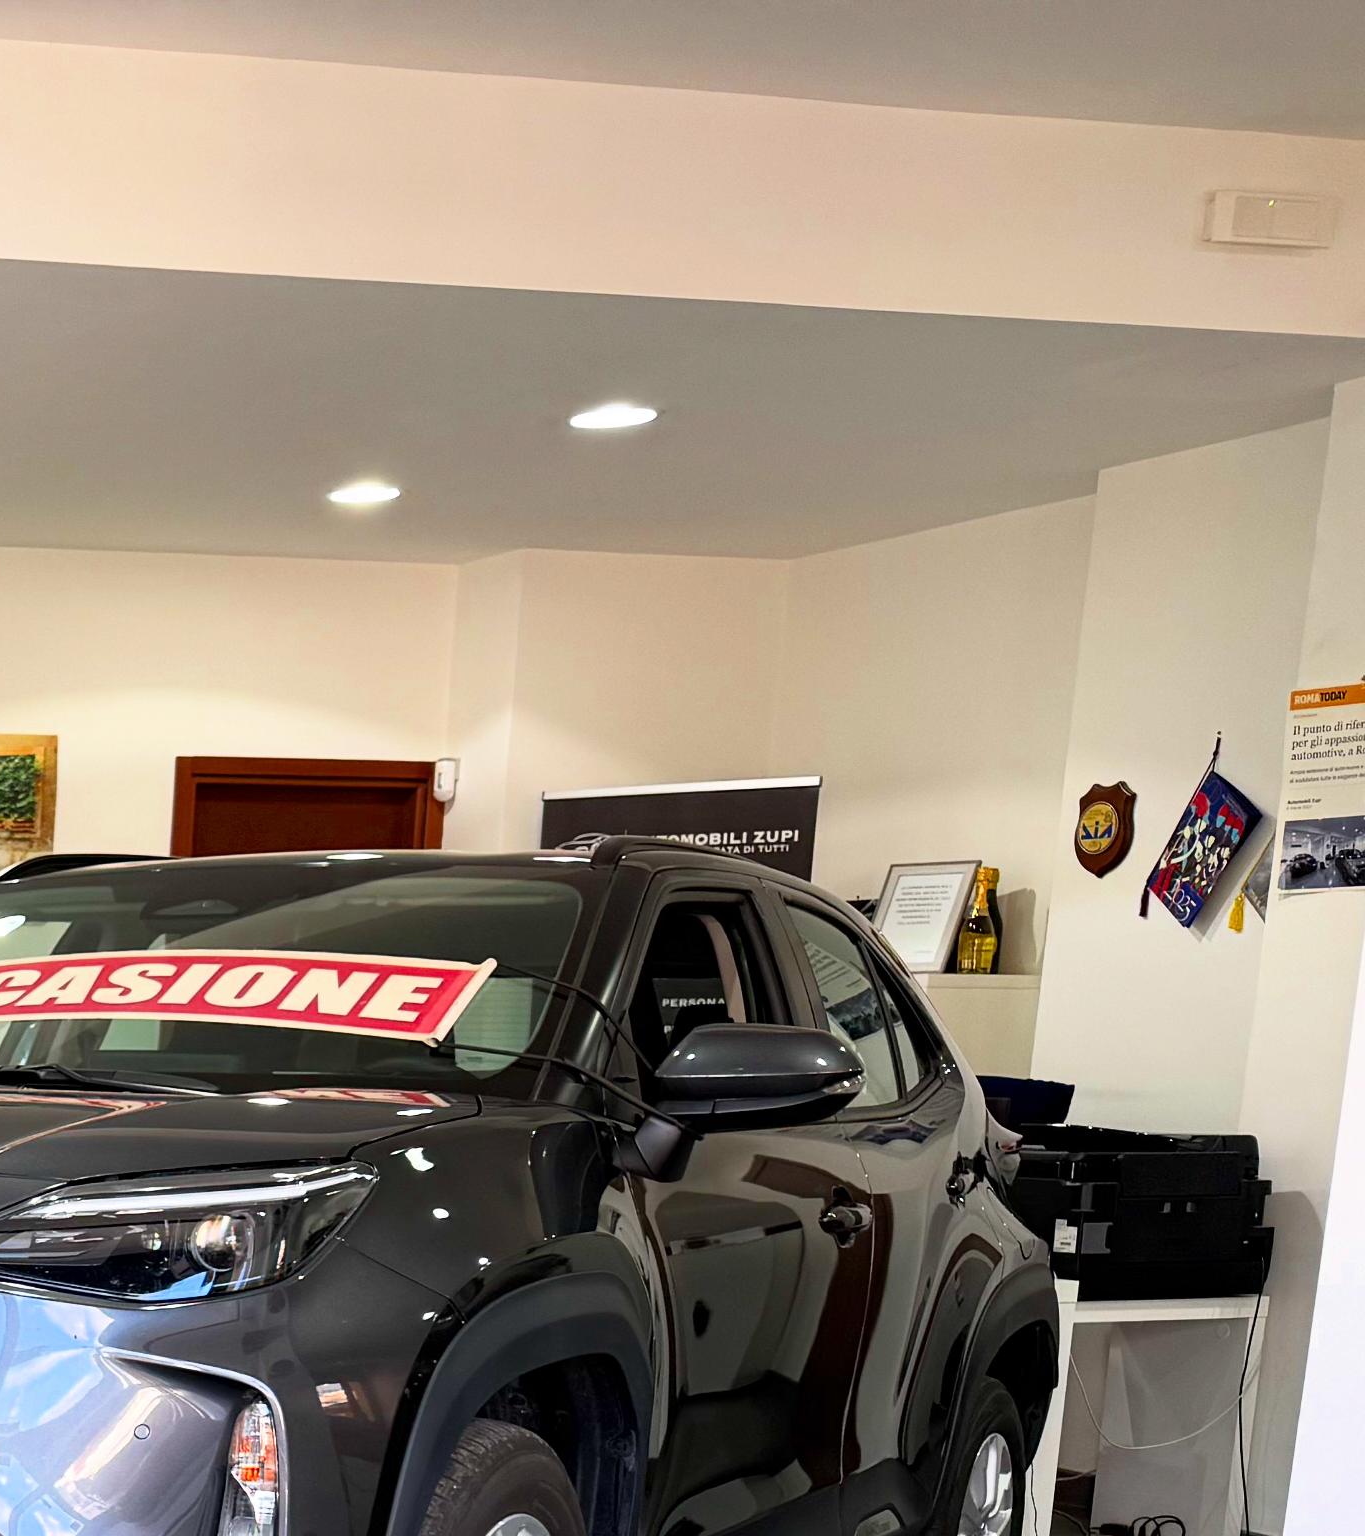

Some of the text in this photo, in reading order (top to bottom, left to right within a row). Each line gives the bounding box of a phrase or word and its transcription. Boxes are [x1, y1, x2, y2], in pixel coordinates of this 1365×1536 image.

[1294, 690, 1347, 705] ROMATODAY
[1293, 720, 1365, 738] Il punto di rifer
[1291, 733, 1365, 751] per gli appassio
[1348, 748, 1354, 756] a
[753, 829, 800, 843] ZUPI
[743, 845, 755, 854] DI
[758, 844, 789, 853] TUTTI
[661, 998, 725, 1007] PERSONA
